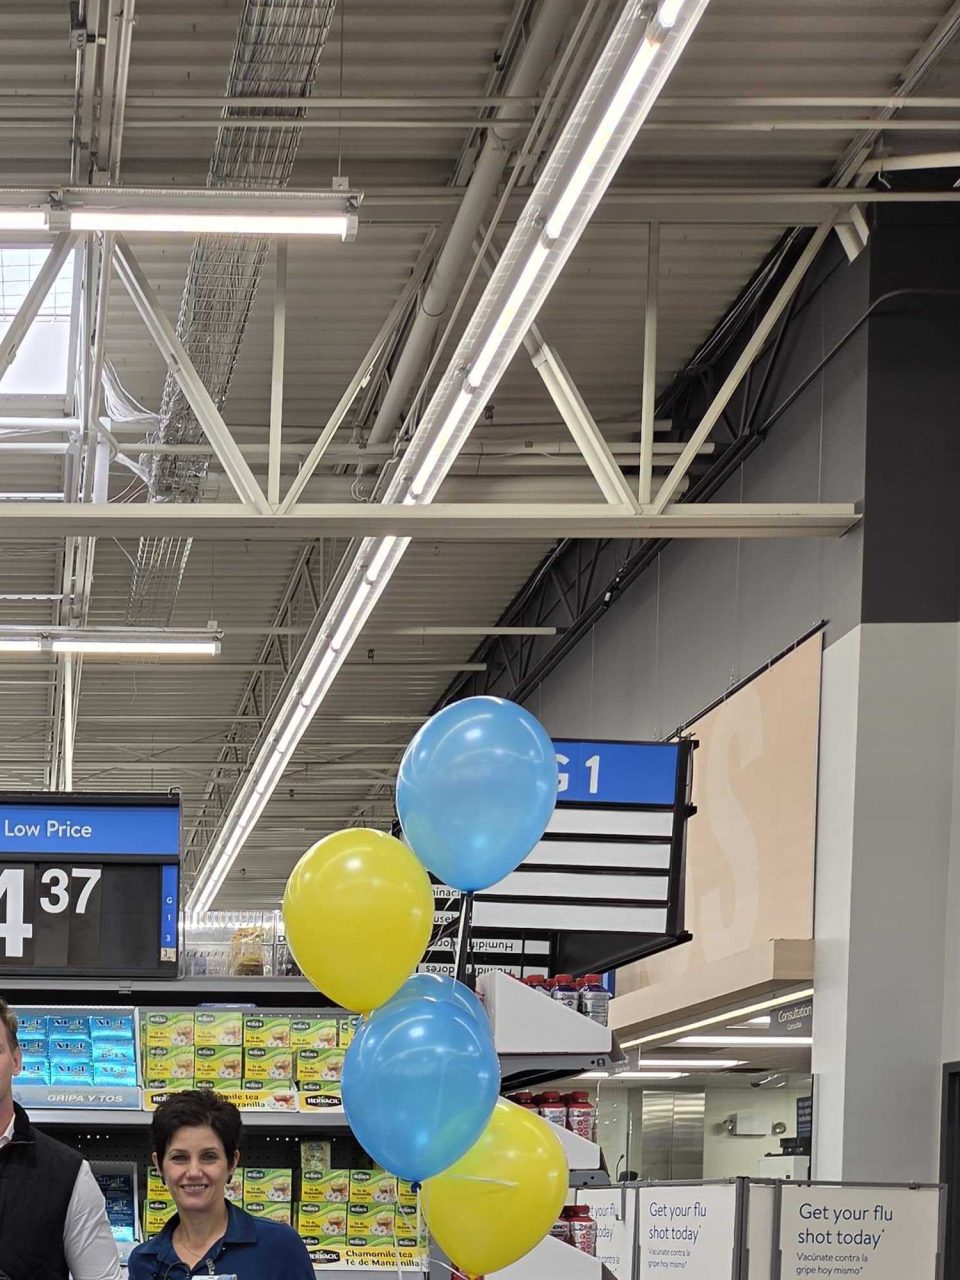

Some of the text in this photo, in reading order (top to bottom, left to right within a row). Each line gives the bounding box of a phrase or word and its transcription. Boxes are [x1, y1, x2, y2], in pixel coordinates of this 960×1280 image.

[585, 755, 600, 794] 1
[5, 820, 40, 837] Low
[47, 820, 92, 838] Price
[650, 1202, 707, 1221] Get your flu
[799, 1203, 893, 1225] Get your flu
[649, 1225, 669, 1239] shot
[798, 1228, 832, 1244] shot
[346, 1250, 396, 1258] Chamomile
[862, 1254, 868, 1262] la
[796, 1266, 816, 1275] gripe
[818, 1266, 832, 1276] hoy
